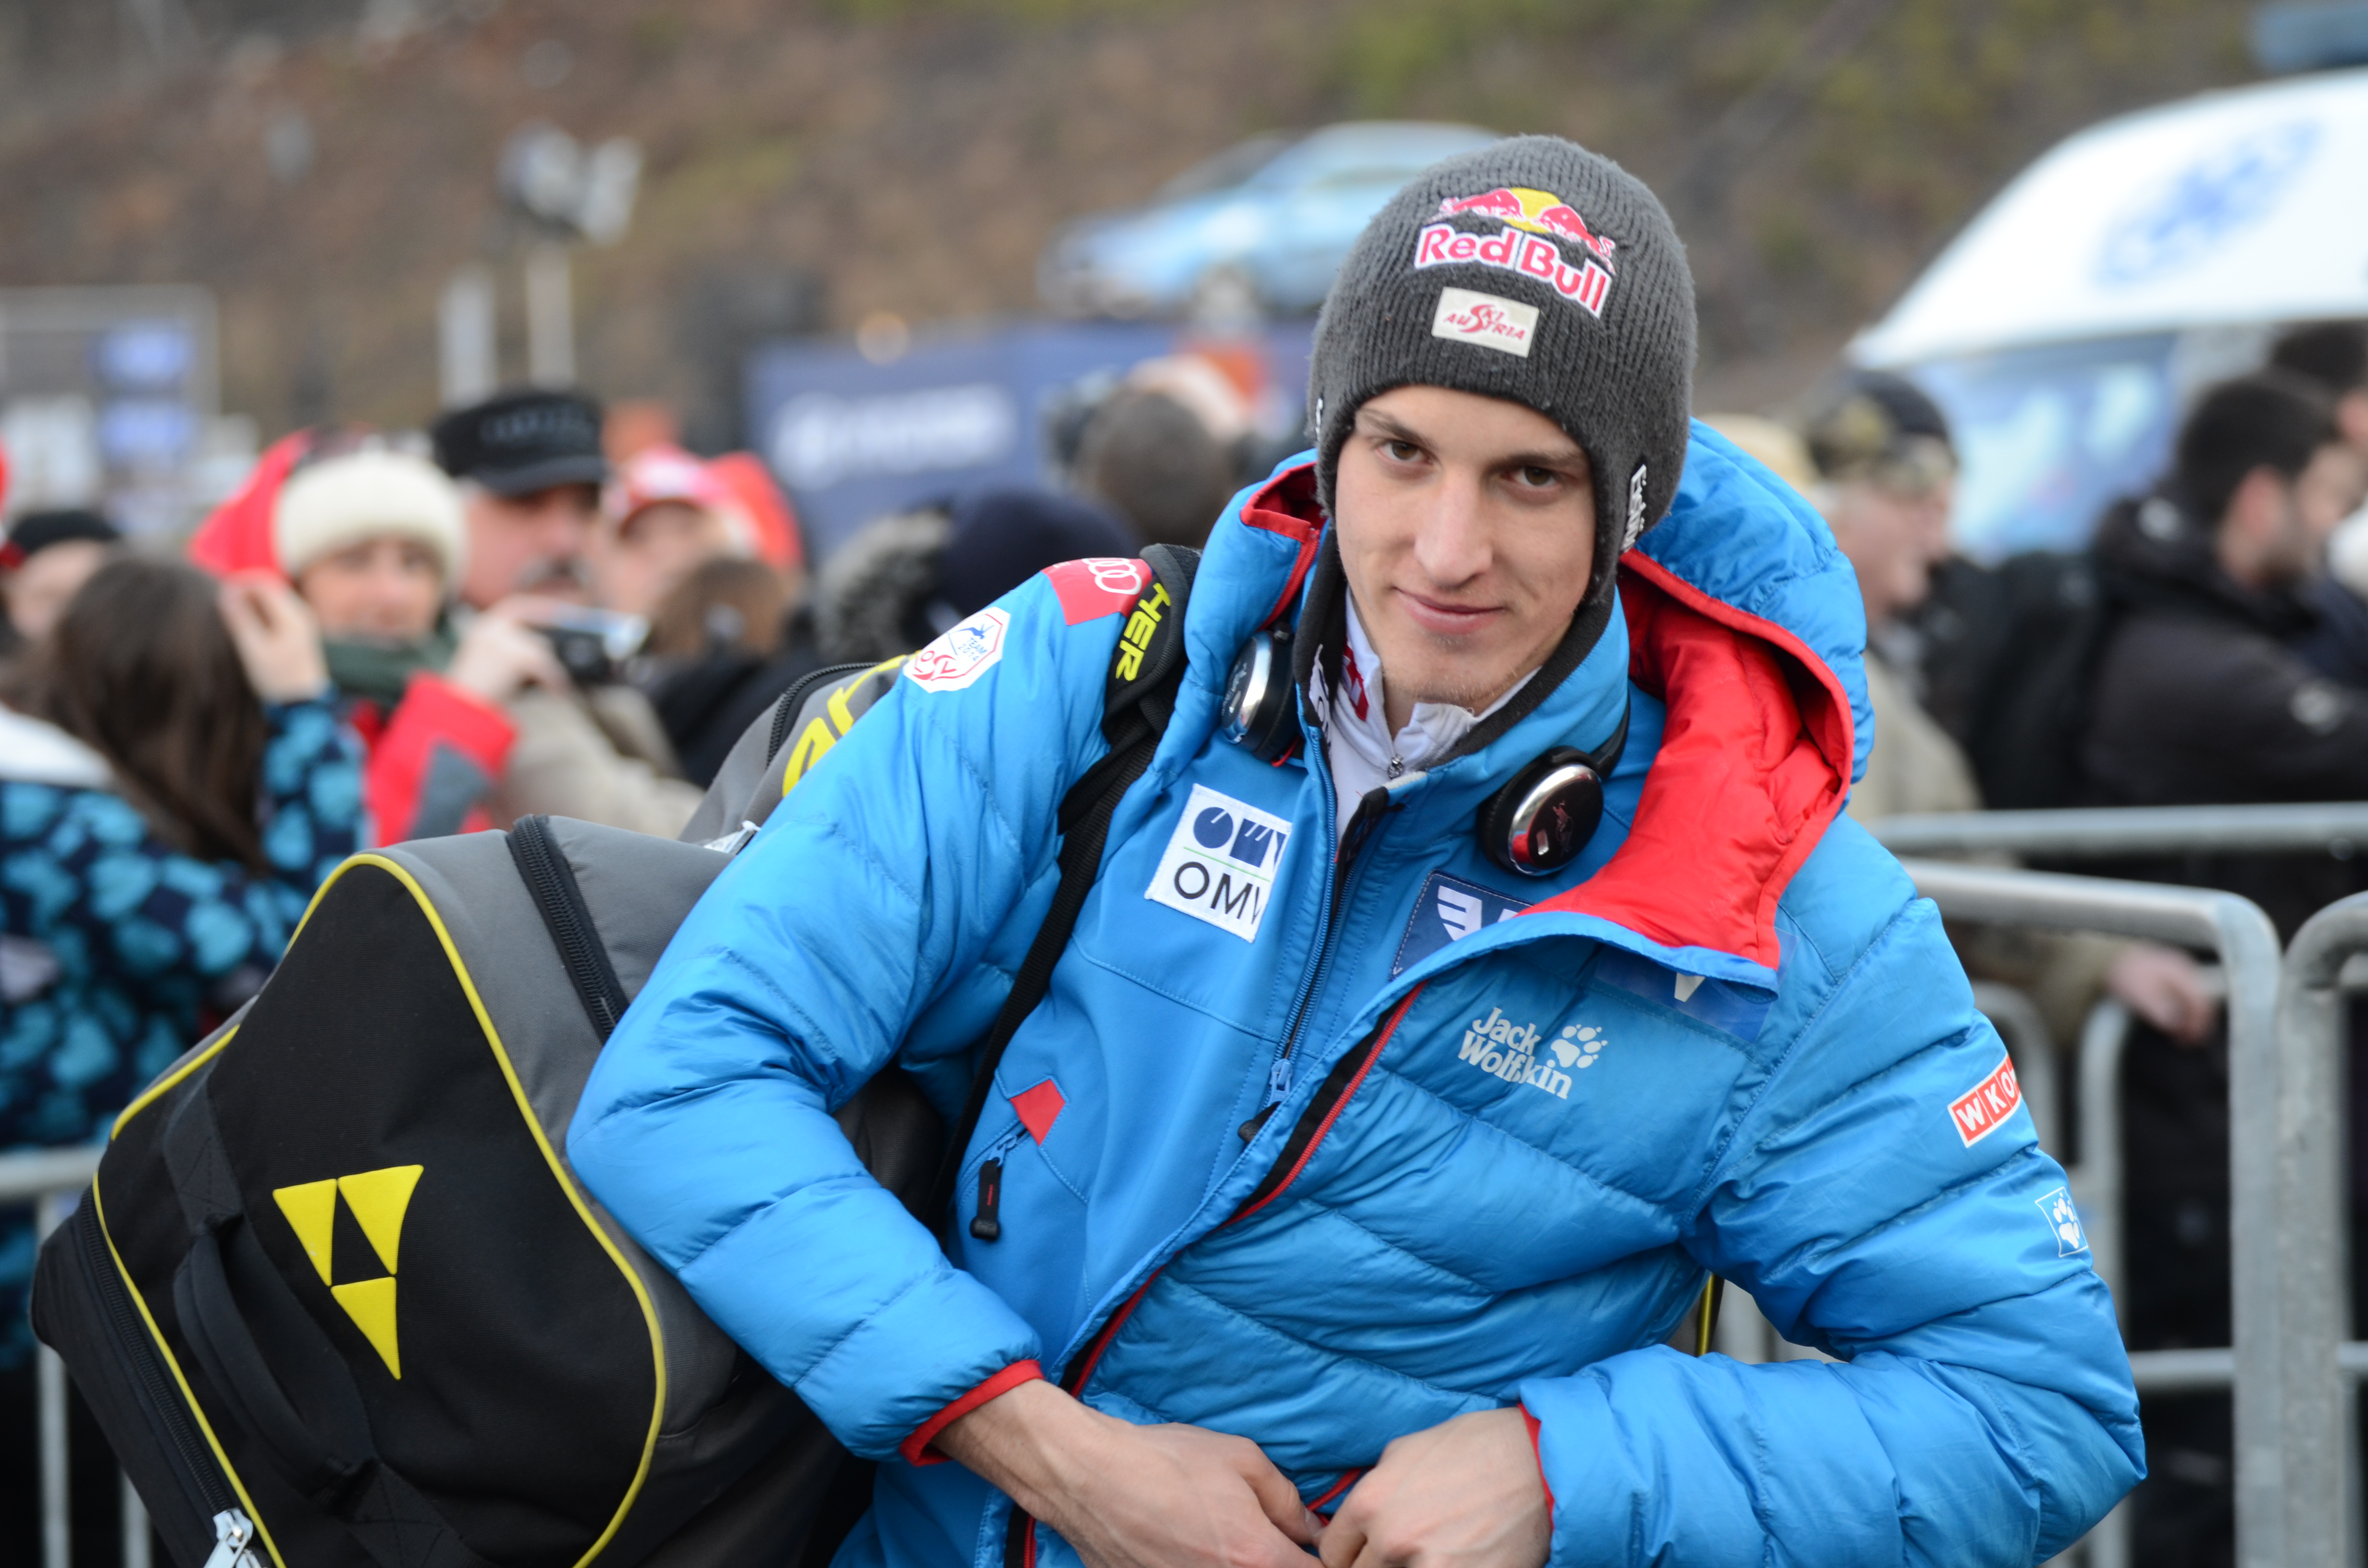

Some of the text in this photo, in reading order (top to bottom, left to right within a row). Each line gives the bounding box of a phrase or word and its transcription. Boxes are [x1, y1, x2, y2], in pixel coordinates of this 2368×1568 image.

[1417, 226, 1608, 315] Red Bull
[967, 637, 988, 654] TEAM
[1472, 1007, 1542, 1056] Jack
[1956, 1067, 2017, 1132] WKO
